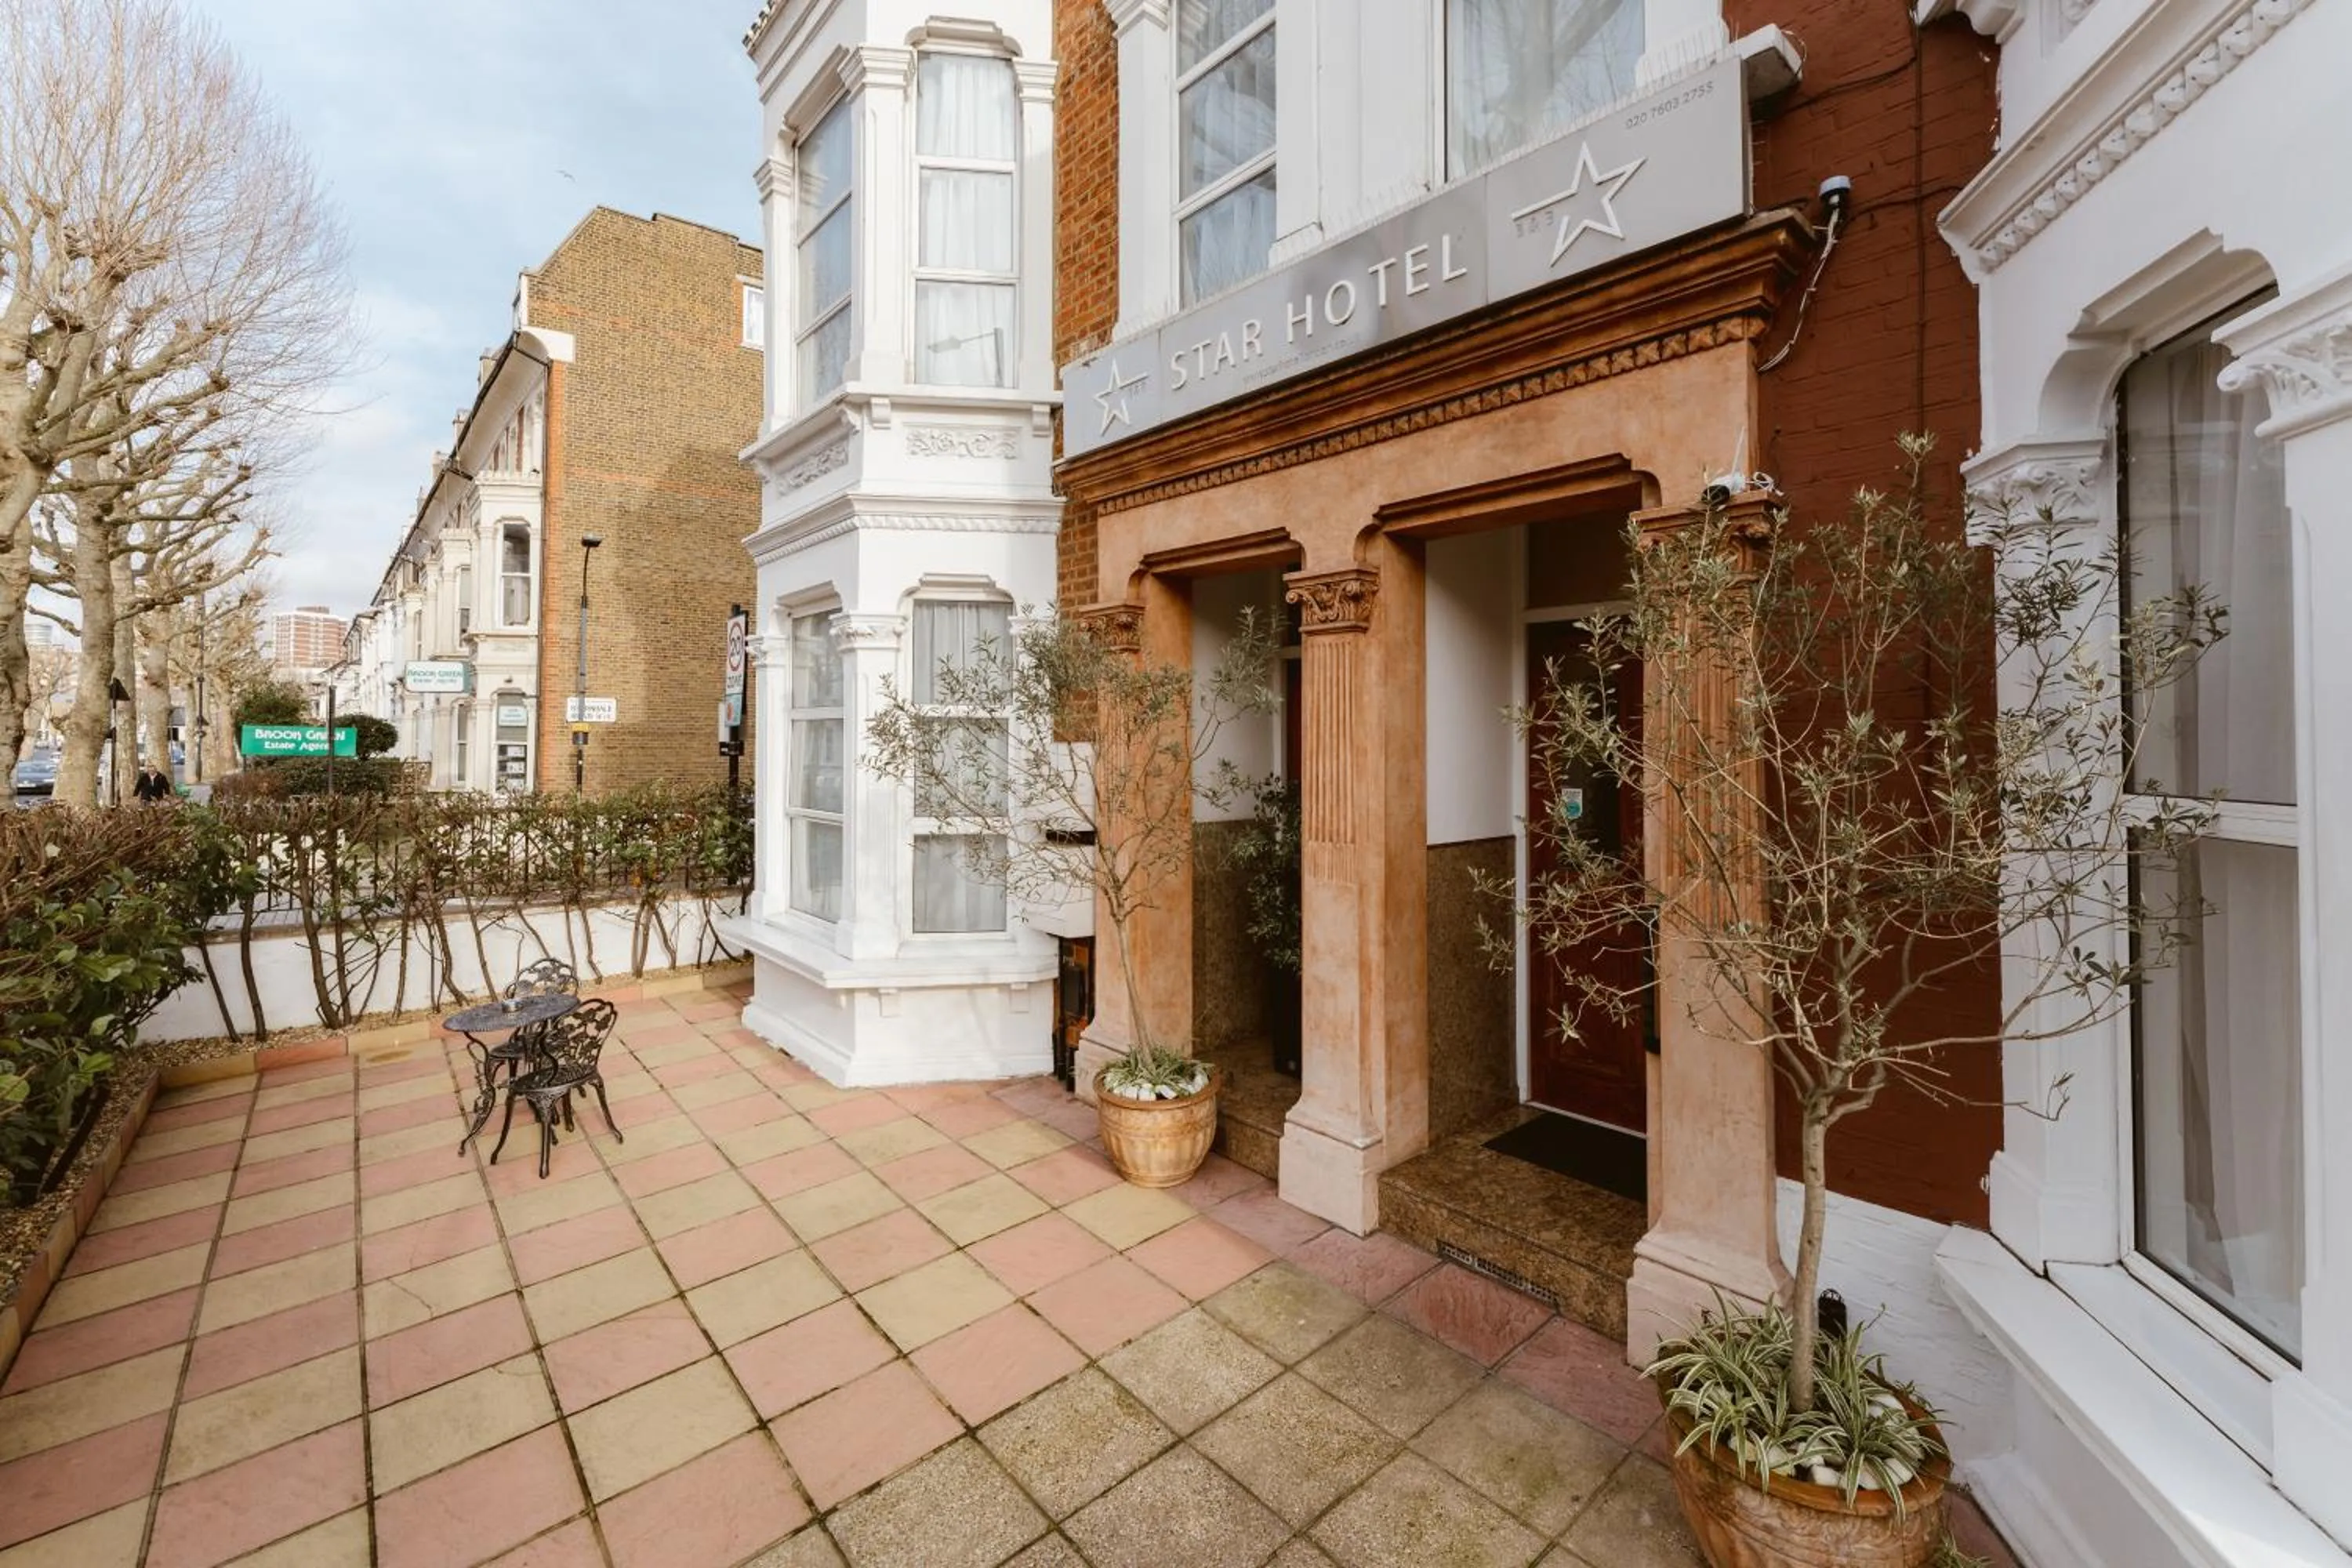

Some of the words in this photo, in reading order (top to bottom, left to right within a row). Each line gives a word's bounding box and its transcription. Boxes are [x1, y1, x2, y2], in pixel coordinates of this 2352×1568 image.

[1626, 111, 1647, 129] 020
[1651, 96, 1679, 118] 7603
[1682, 81, 1714, 103] 2755
[1171, 319, 1264, 391] STAR
[1287, 234, 1468, 343] HOTEL
[306, 730, 346, 741] GREN
